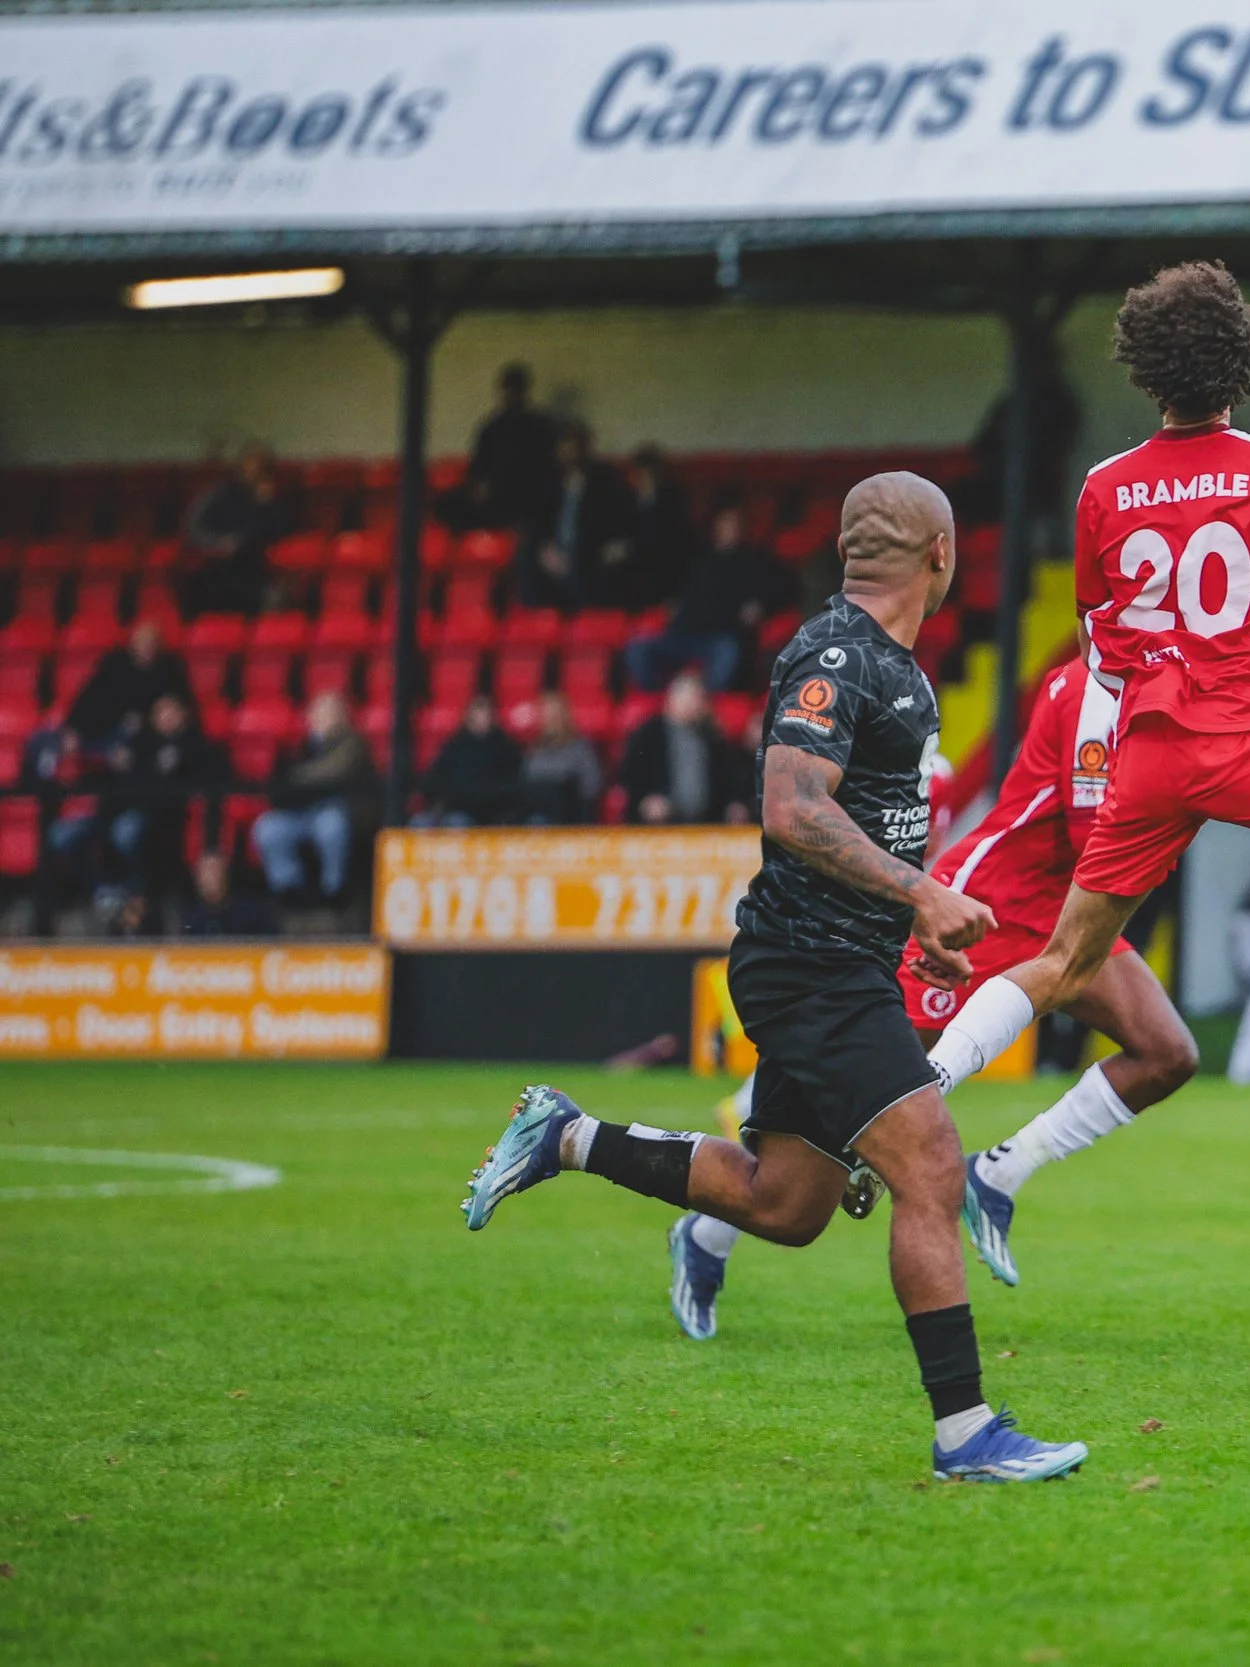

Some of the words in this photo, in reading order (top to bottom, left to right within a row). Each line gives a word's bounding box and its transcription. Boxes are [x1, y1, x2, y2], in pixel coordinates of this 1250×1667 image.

[578, 42, 989, 150] Careers
[1006, 32, 1122, 135] to
[0, 75, 447, 164] ts&Boots
[1116, 473, 1250, 512] BRAMBLE
[148, 950, 254, 995] Access
[262, 949, 381, 996] Control
[160, 1003, 242, 1057] Entry
[253, 1003, 381, 1058] Systems
